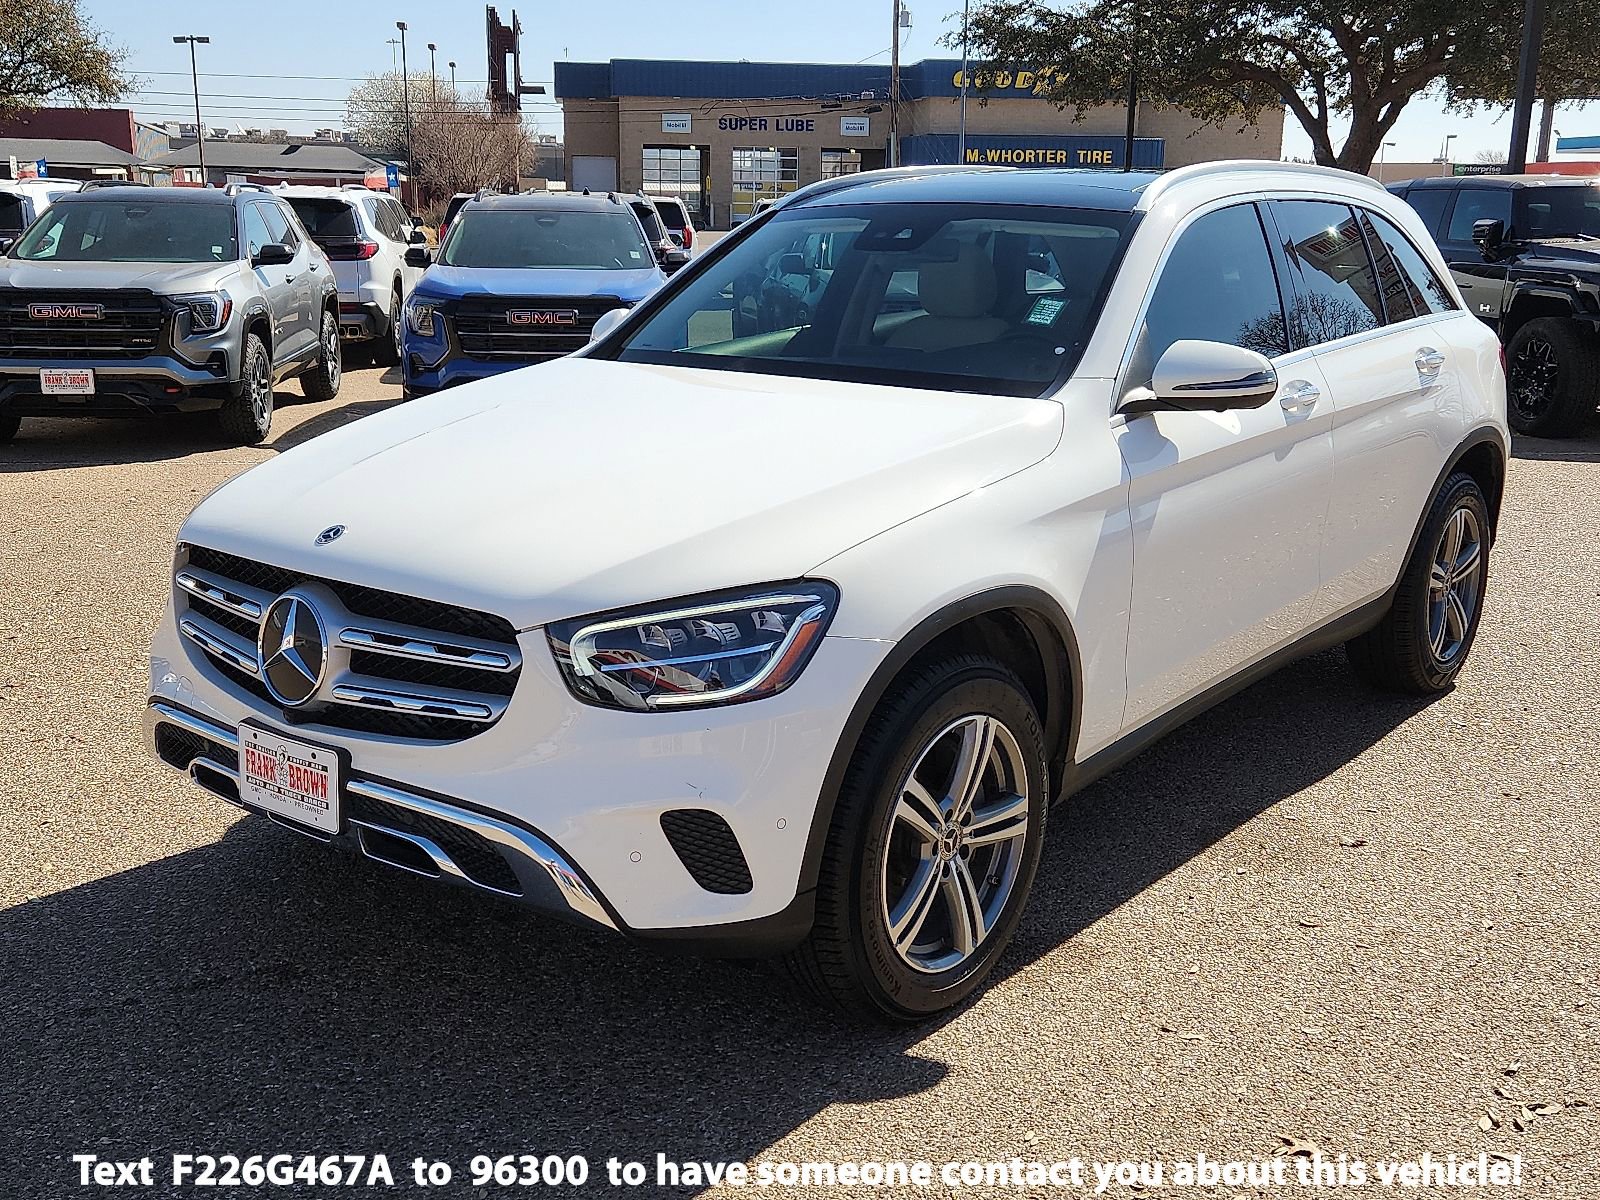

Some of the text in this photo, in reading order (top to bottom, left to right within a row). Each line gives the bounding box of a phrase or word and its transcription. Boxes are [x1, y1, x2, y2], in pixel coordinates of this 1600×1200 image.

[718, 117, 815, 132] SUPER LUBE
[966, 149, 1113, 164] McWHORTER TIRE
[31, 305, 98, 318] GMC
[511, 311, 573, 324] GMC
[245, 748, 277, 784] FRANK
[287, 764, 329, 799] BROWN
[248, 776, 264, 787] AUTO
[250, 785, 324, 815] GMC HONDA PREOWNED
